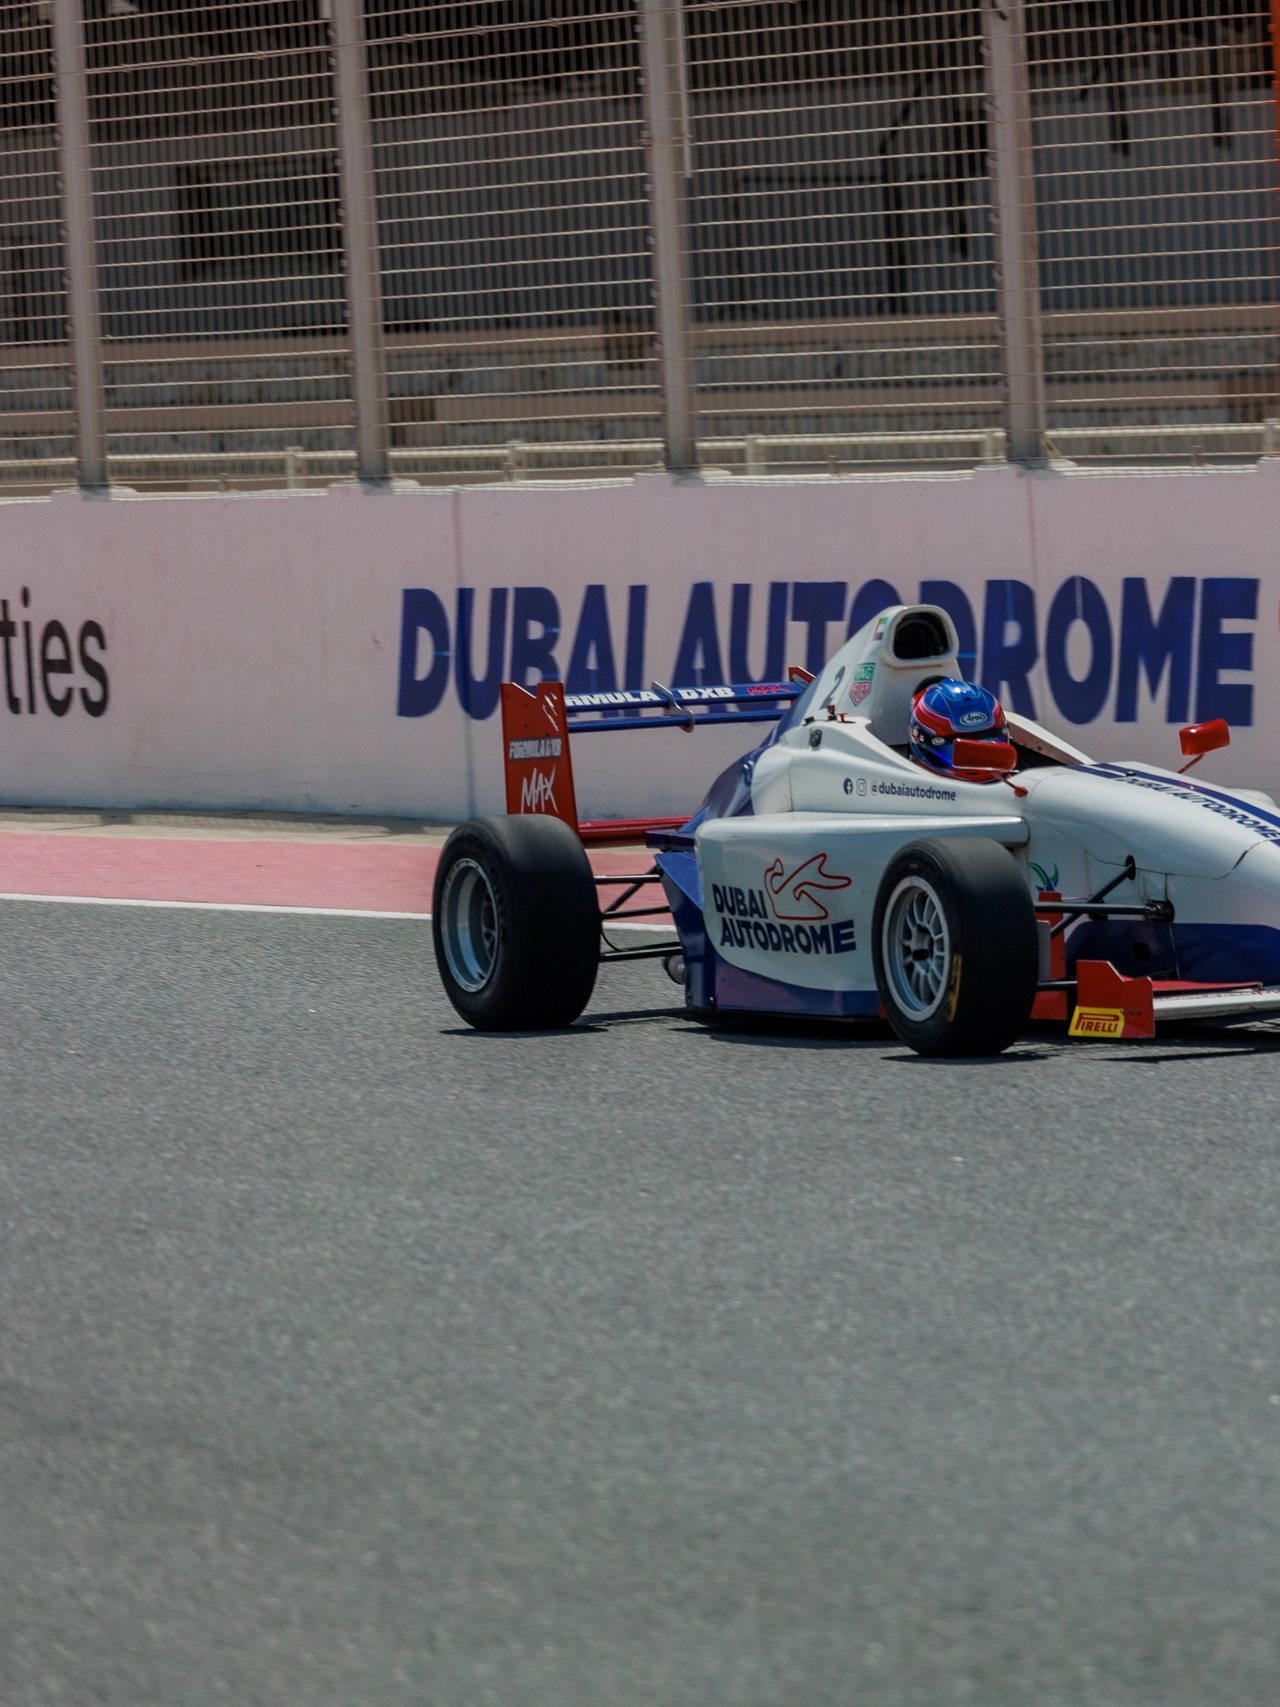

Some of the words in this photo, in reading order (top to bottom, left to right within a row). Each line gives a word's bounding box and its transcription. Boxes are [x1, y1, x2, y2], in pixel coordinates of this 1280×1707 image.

[396, 584, 648, 720] DUBAI
[668, 578, 1259, 726] AUTDROME
[854, 667, 872, 681] TAG
[565, 691, 660, 707] RMULA
[679, 687, 735, 700] DXB
[521, 764, 559, 814] MAX
[871, 781, 956, 801] @dubaiautodrome
[712, 883, 768, 919] DUBAI
[720, 917, 856, 954] AUTODROME
[1074, 1012, 1120, 1033] PIRELLI
